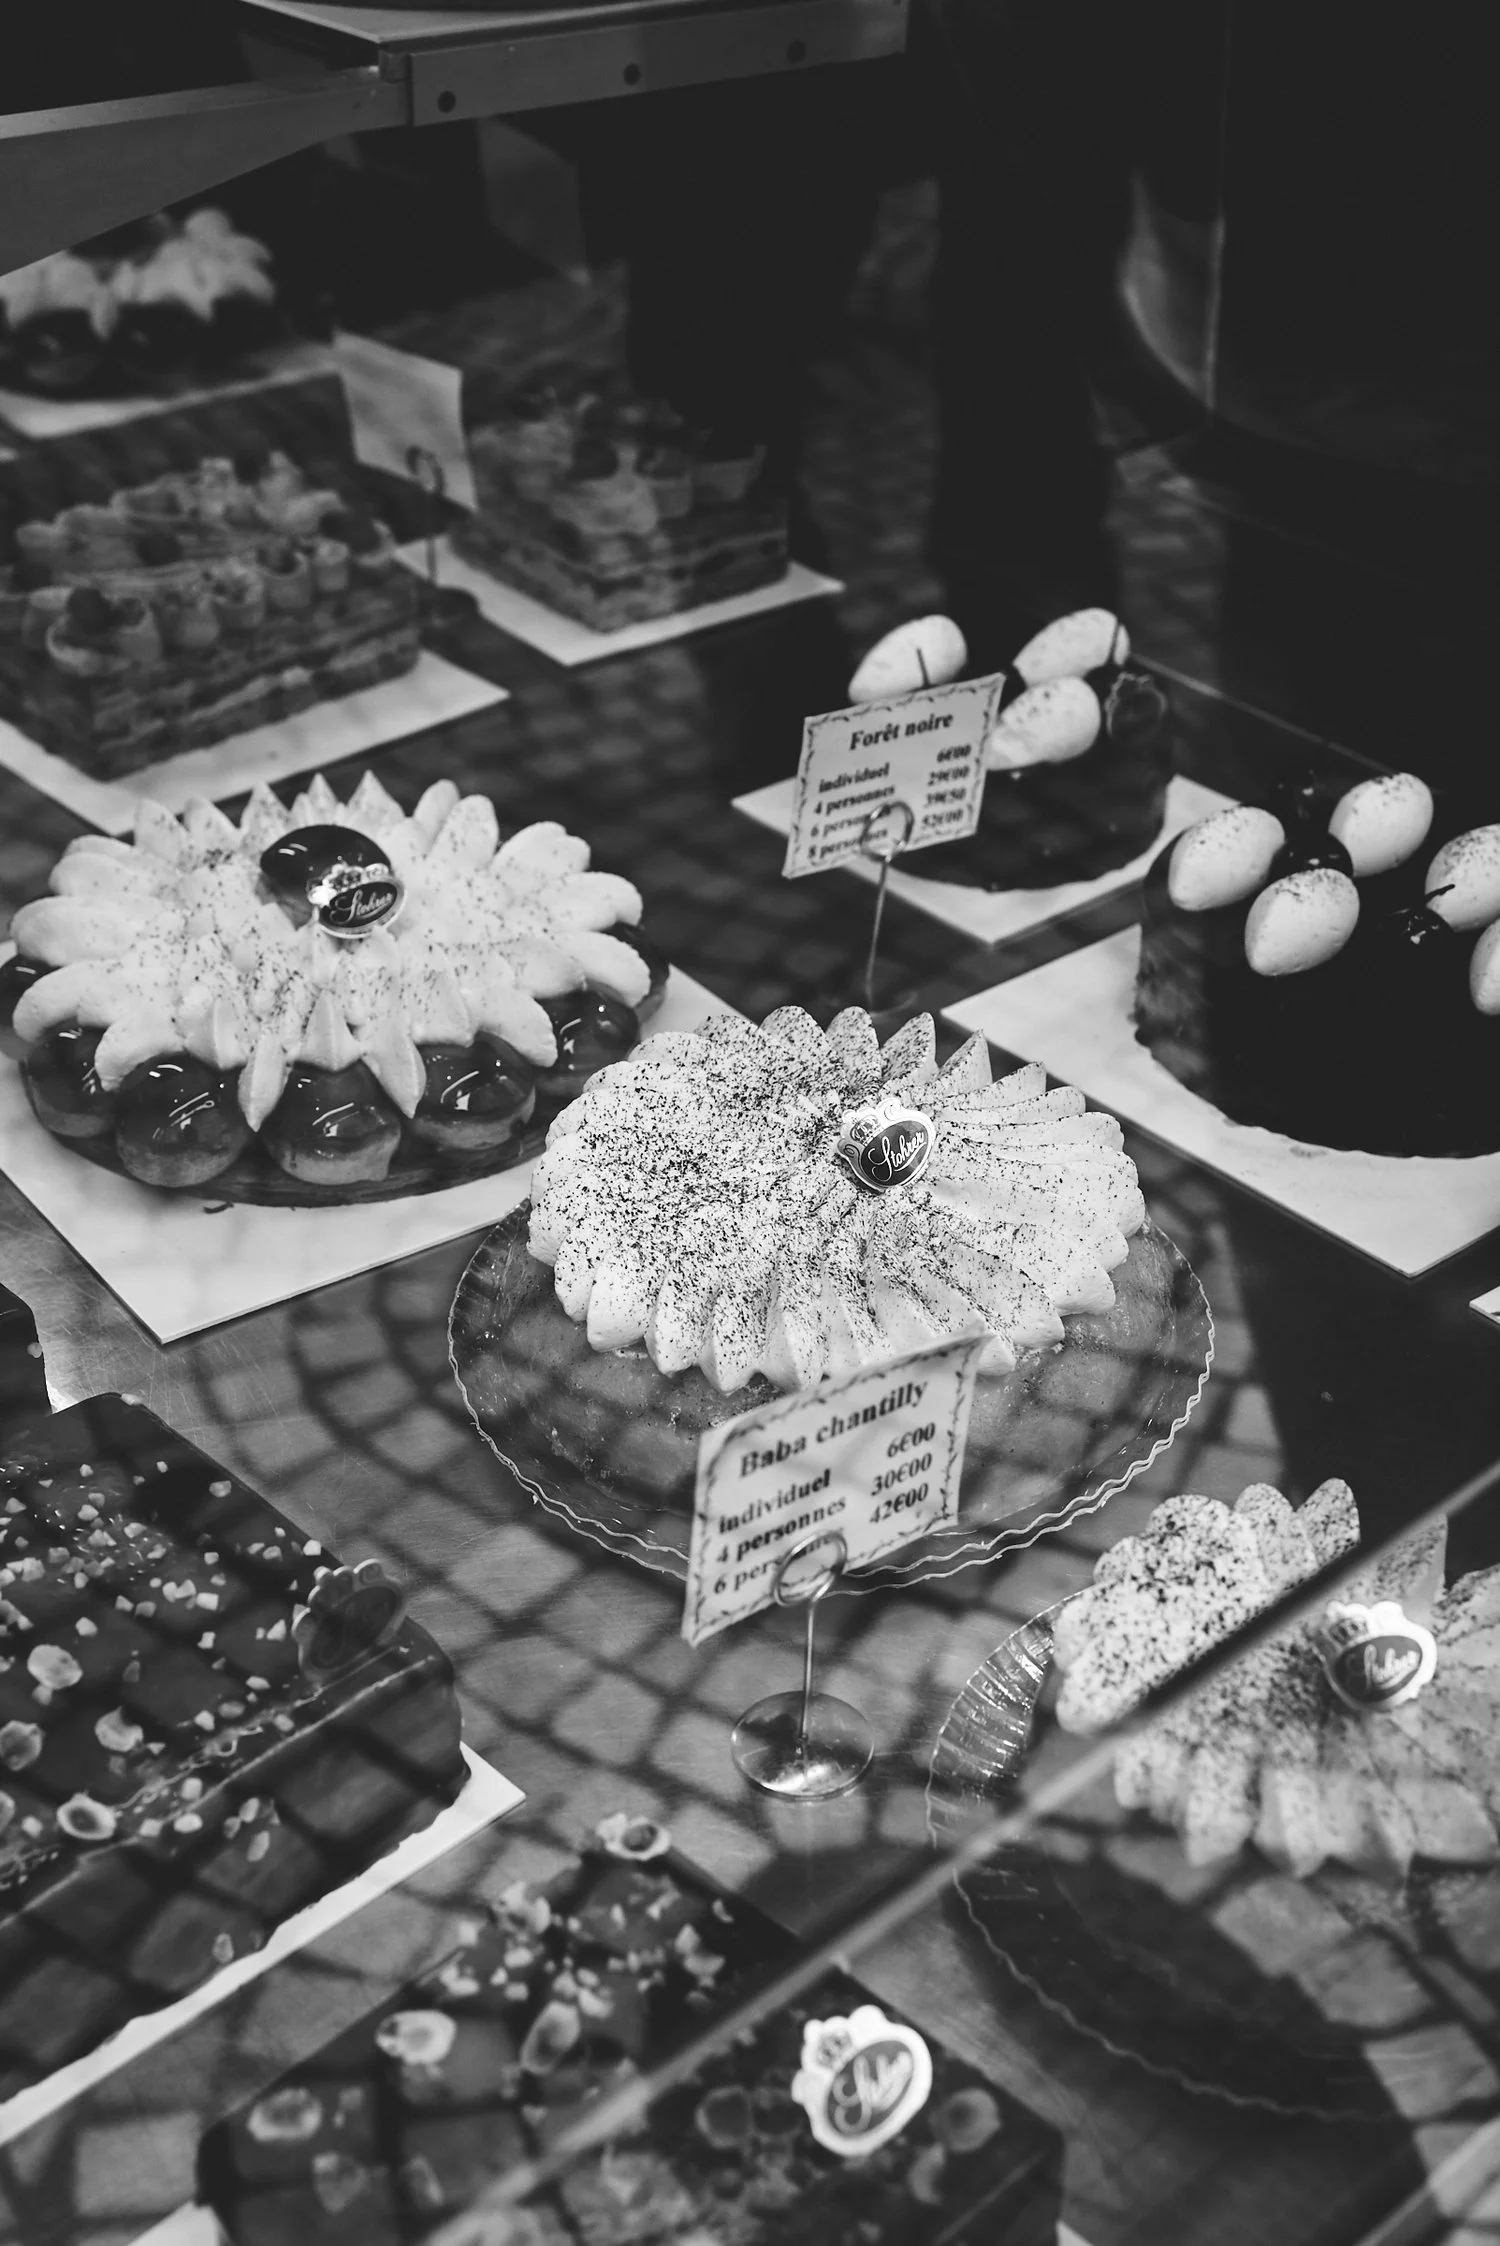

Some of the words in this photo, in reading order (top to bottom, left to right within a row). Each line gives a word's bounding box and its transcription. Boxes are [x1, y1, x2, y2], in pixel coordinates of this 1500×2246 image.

[850, 723, 899, 750] Forêt
[905, 714, 953, 736] noire
[814, 801, 822, 815] 4
[826, 785, 895, 816] personnes
[819, 762, 890, 793] individuel
[868, 1132, 927, 1181] Stohrer
[739, 1435, 807, 1480] Baba
[816, 1380, 928, 1444] chantilly
[717, 1545, 728, 1562] 4
[737, 1497, 846, 1562] personnes
[871, 1452, 933, 1497] 30€00
[719, 1468, 831, 1533] individuel
[887, 1421, 936, 1458] 6€00
[713, 1574, 727, 1594] 6
[869, 1482, 929, 1524] 42€00
